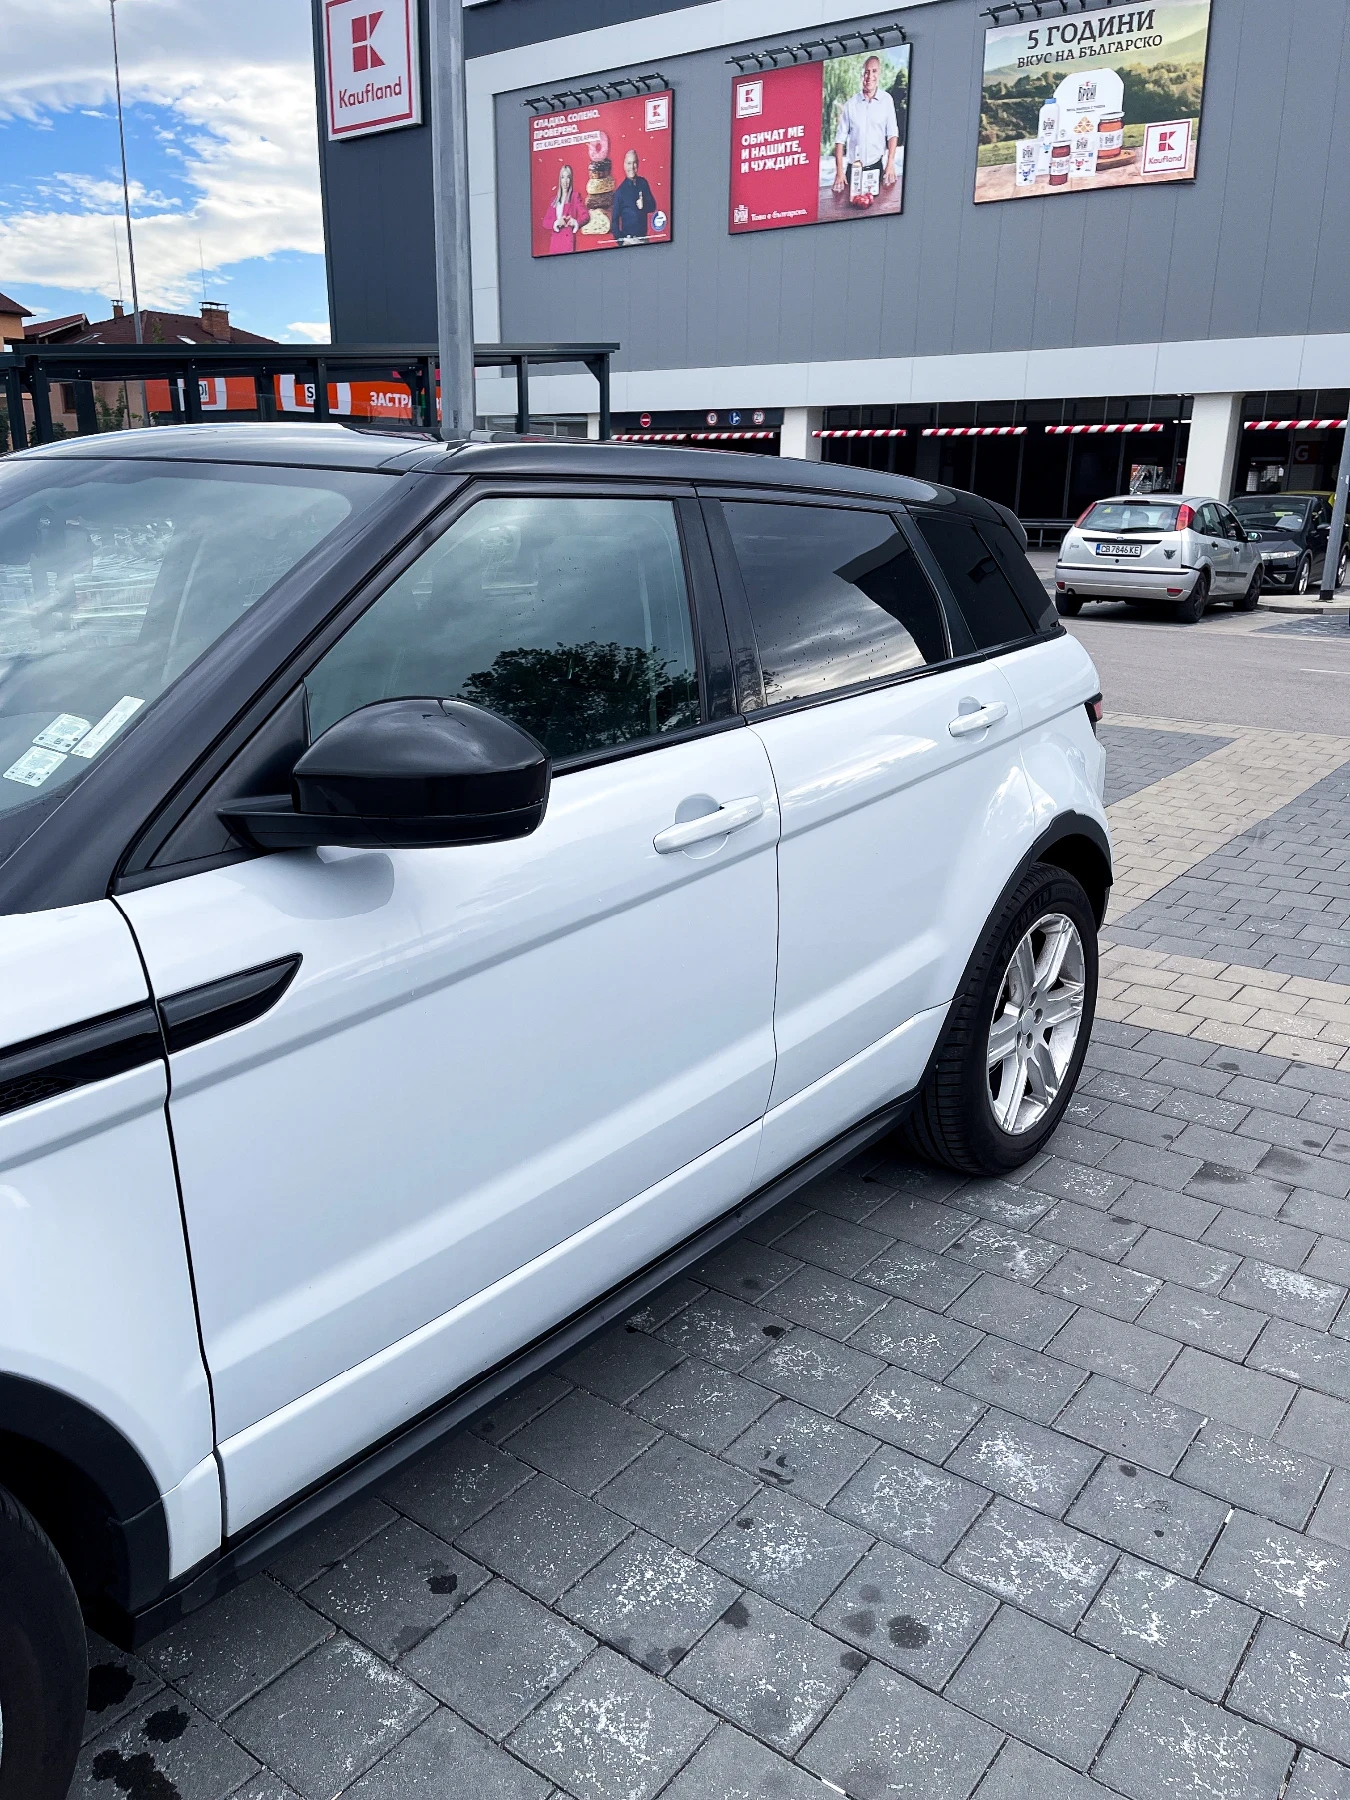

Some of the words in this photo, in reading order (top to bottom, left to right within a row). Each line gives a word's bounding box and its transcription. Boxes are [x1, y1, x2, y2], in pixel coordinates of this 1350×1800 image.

[1027, 28, 1039, 49] 5
[1045, 9, 1156, 46] ГОДИНИ
[1017, 52, 1052, 68] ВКУС
[1055, 49, 1075, 62] НА
[1078, 34, 1163, 59] БЪЛГАРСКО
[338, 75, 402, 109] Kaufland
[741, 128, 786, 146] ОБИЧАТ
[787, 125, 804, 139] МЕ
[741, 148, 749, 160] И
[751, 140, 801, 159] НАШИТЕ,
[1148, 153, 1183, 164] Kaufland
[741, 161, 749, 174] И
[751, 153, 809, 172] ЧУЖДИТЕ.
